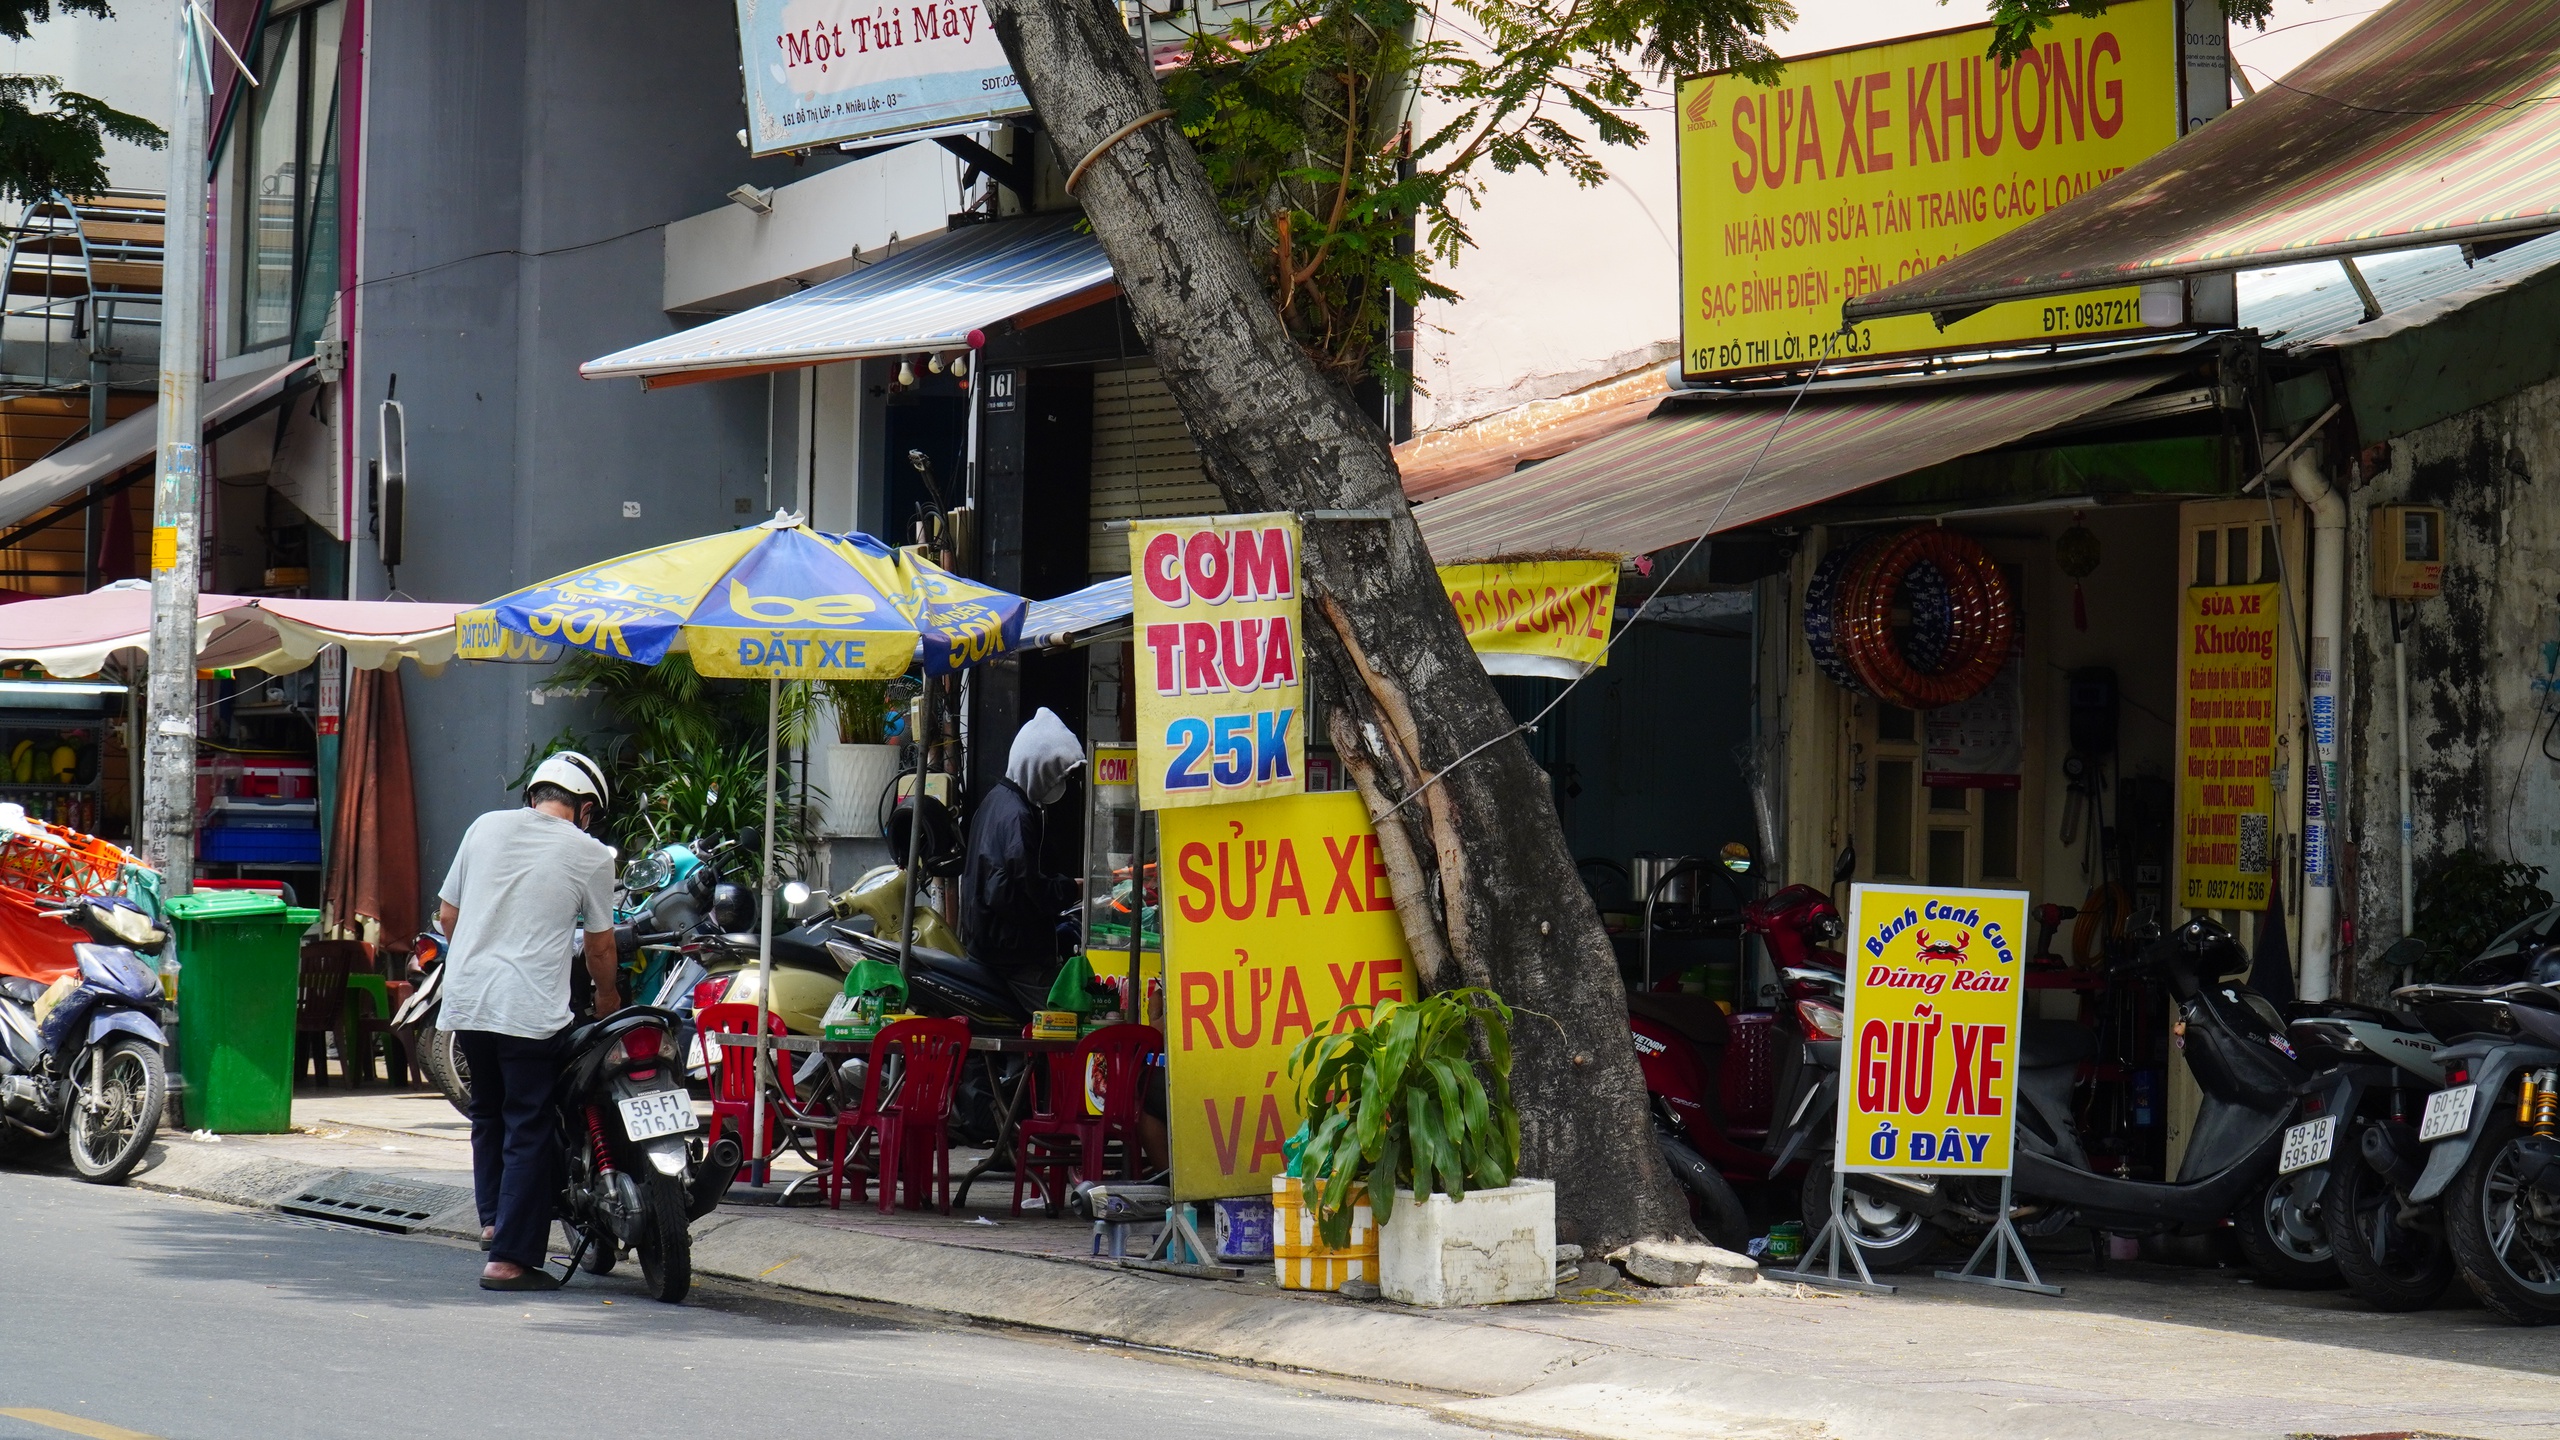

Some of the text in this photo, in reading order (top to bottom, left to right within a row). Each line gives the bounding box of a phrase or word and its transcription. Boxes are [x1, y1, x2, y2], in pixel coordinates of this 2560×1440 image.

[851, 6, 904, 53] Túi
[911, 0, 978, 44] Mây
[782, 114, 796, 127] 161
[807, 108, 819, 123] Thị
[819, 106, 831, 119] Lời
[837, 104, 845, 116] P.
[845, 99, 867, 114] Nhiêu
[868, 97, 881, 111] Lộc
[886, 94, 897, 107] Q3
[1835, 72, 1894, 178] XE
[1907, 31, 2125, 167] KHƯƠNG
[1687, 119, 1718, 132] HONDA
[1724, 213, 1775, 261] NHẬN
[1781, 210, 1821, 248] SƠN
[1827, 197, 1869, 242] SỬA
[1872, 190, 1912, 236] TÂN
[1917, 182, 1987, 231] TRANG
[1993, 171, 2036, 220] CÁC
[1701, 283, 1737, 327] SẠC
[1742, 269, 1781, 316] BÌNH
[1787, 267, 1829, 315] ĐIỆN
[1844, 256, 1882, 299] ĐÈN
[2043, 300, 2141, 332] ĐT: 0937211
[1692, 348, 1714, 371] 167
[1719, 339, 1742, 367] ĐỖ
[1746, 339, 1770, 366] THỊ
[1775, 331, 1804, 362] LỜI,
[1846, 327, 1872, 354] Q.3
[989, 373, 1012, 398] 161
[1143, 527, 1294, 608] CƠM
[730, 578, 875, 624] be
[1474, 574, 1524, 633] CÁC
[1514, 586, 1578, 648] LOẠI
[1577, 585, 1612, 640] XE
[2201, 591, 2261, 616] SỬA XE
[529, 603, 647, 657] 50K
[938, 610, 1006, 669] 50K
[2194, 624, 2274, 660] Khương
[738, 631, 866, 676] ĐẶT XE
[1146, 615, 1298, 696] TRƯA
[2263, 700, 2272, 718] xe
[1164, 708, 1295, 792] 25K
[2190, 726, 2271, 750] HONDA, YAMAHA, PIAGGIO
[2188, 755, 2205, 779] Nâng
[2206, 751, 2218, 778] cấp
[2255, 755, 2270, 777] ECM
[2202, 785, 2255, 808] HONDA, PIAGGIO
[1178, 820, 1395, 924] SỬA XE
[2188, 879, 2265, 900] ĐT: 0937 211 536
[1865, 899, 2015, 965] Bánh Canh Cua
[1865, 965, 2011, 994] Dũng Râu
[1180, 948, 1403, 1052] RỬA XE
[1631, 1031, 1667, 1053] VIETNAM
[1634, 1041, 1653, 1055] TEAM
[1857, 1001, 2006, 1117] GIỮ XE
[631, 1094, 679, 1117] 59-F1
[2433, 1088, 2468, 1114] 60-F2
[630, 1110, 694, 1137] 616.12
[1204, 1071, 1286, 1177] VÁ
[2291, 1120, 2327, 1147] 59-XB
[2424, 1109, 2467, 1137] 857.71
[1869, 1121, 1991, 1164] Ở ĐÂY
[2284, 1139, 2328, 1170] 595.87
[1244, 1209, 1259, 1218] NEW
